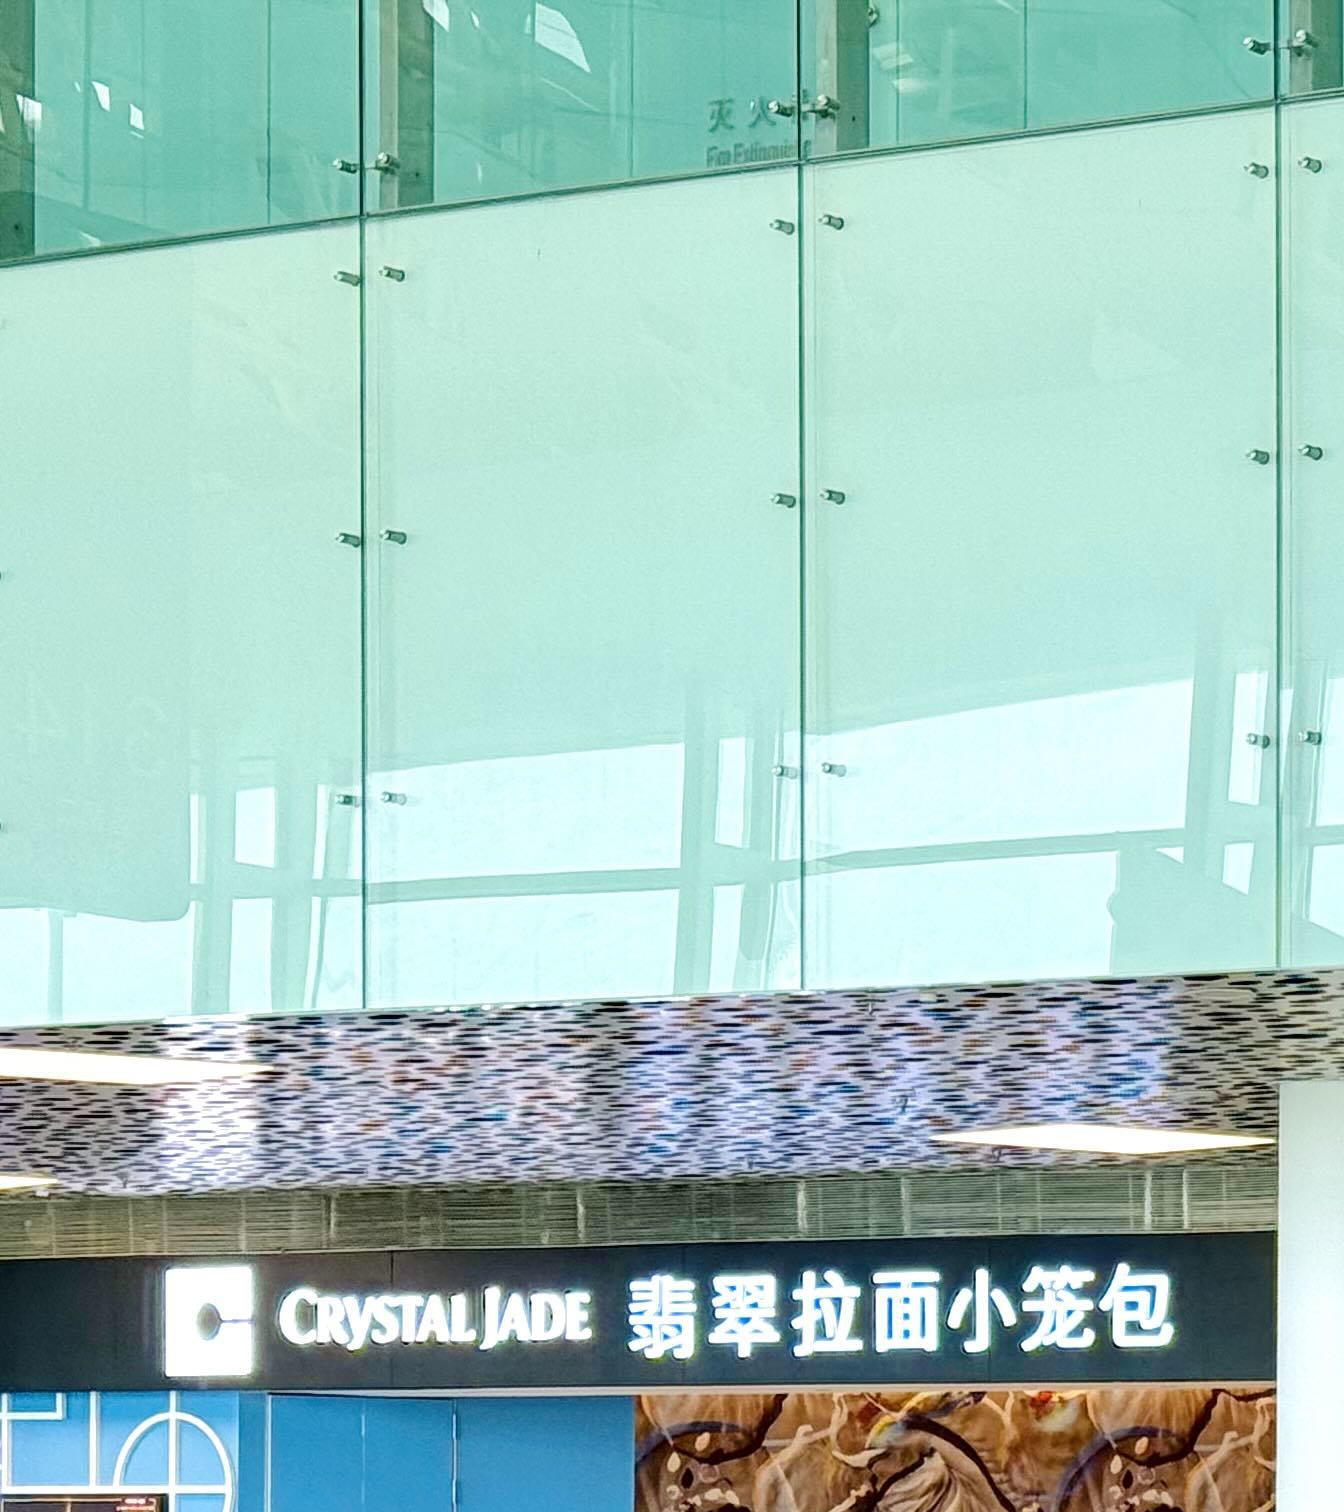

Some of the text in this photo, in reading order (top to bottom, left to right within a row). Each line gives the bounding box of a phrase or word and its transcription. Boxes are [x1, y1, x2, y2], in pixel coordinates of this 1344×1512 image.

[278, 1286, 593, 1351] CRYSTAL JADE
[628, 1263, 1175, 1360] 翡翠拉面小笼包
